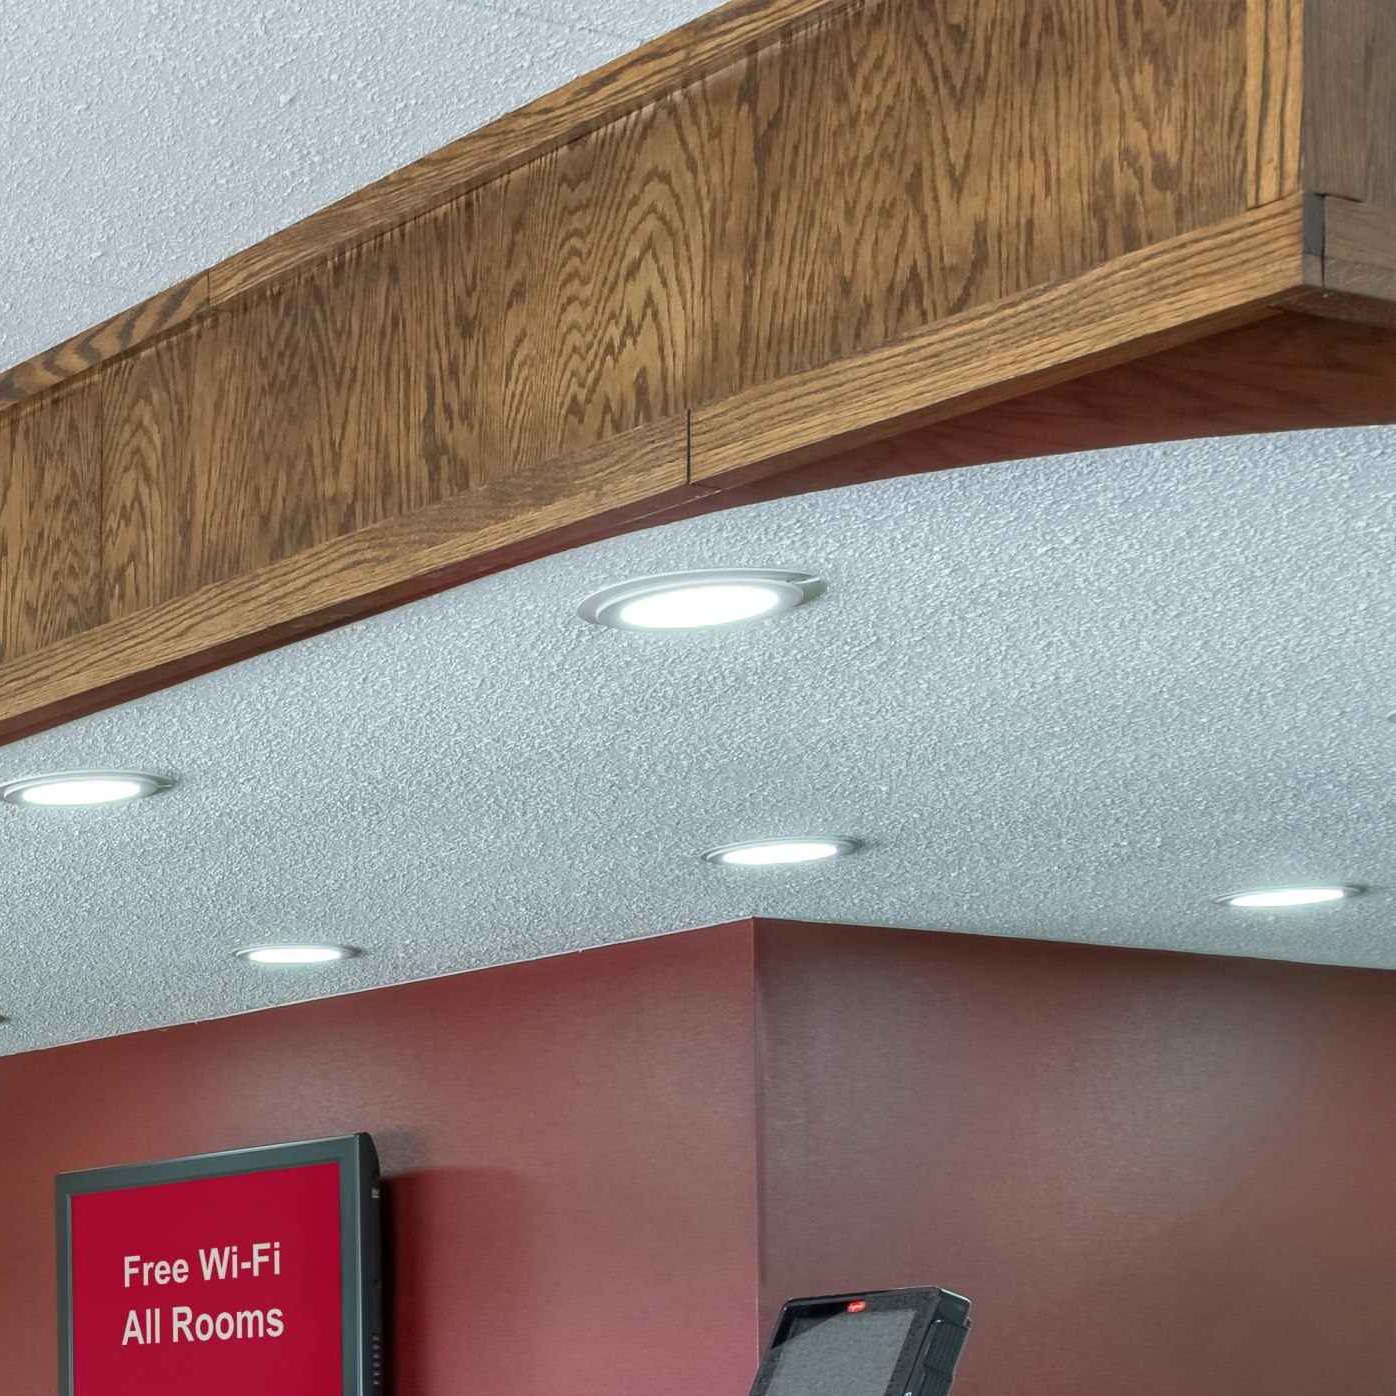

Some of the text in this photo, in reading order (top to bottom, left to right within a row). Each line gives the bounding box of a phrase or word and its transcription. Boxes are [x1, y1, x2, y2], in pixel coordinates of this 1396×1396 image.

[123, 1241, 281, 1288] Free Wi-Fi
[121, 1305, 284, 1346] All Rooms
